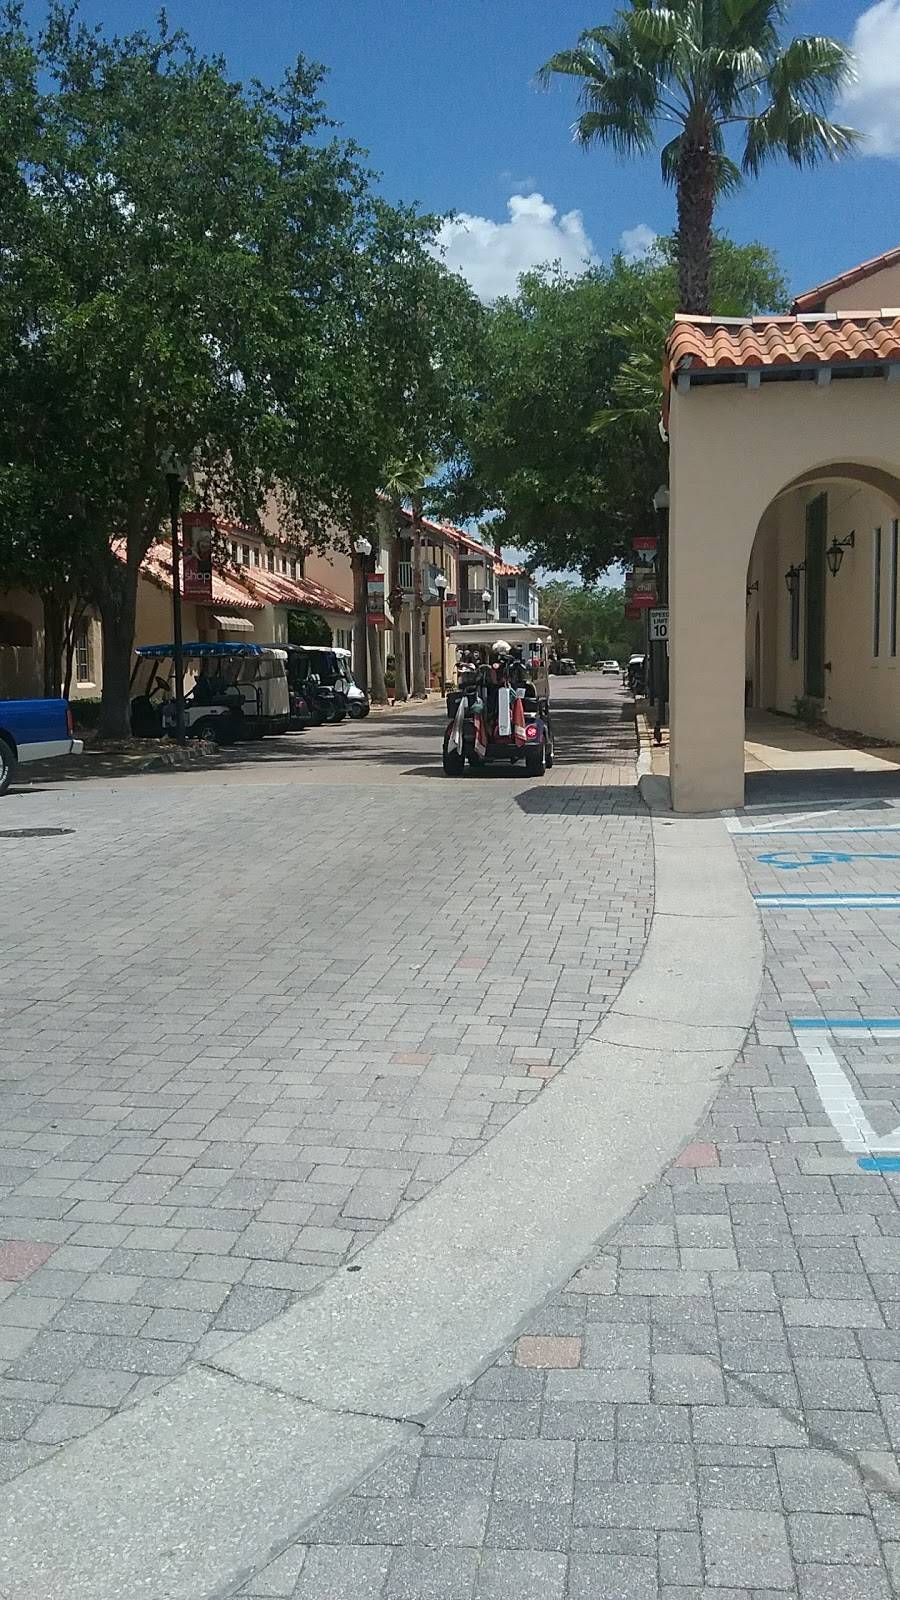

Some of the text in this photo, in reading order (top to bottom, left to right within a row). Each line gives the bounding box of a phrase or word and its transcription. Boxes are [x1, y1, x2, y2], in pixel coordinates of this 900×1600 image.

[185, 569, 210, 584] shop
[636, 583, 652, 592] chill
[654, 624, 667, 637] 10
